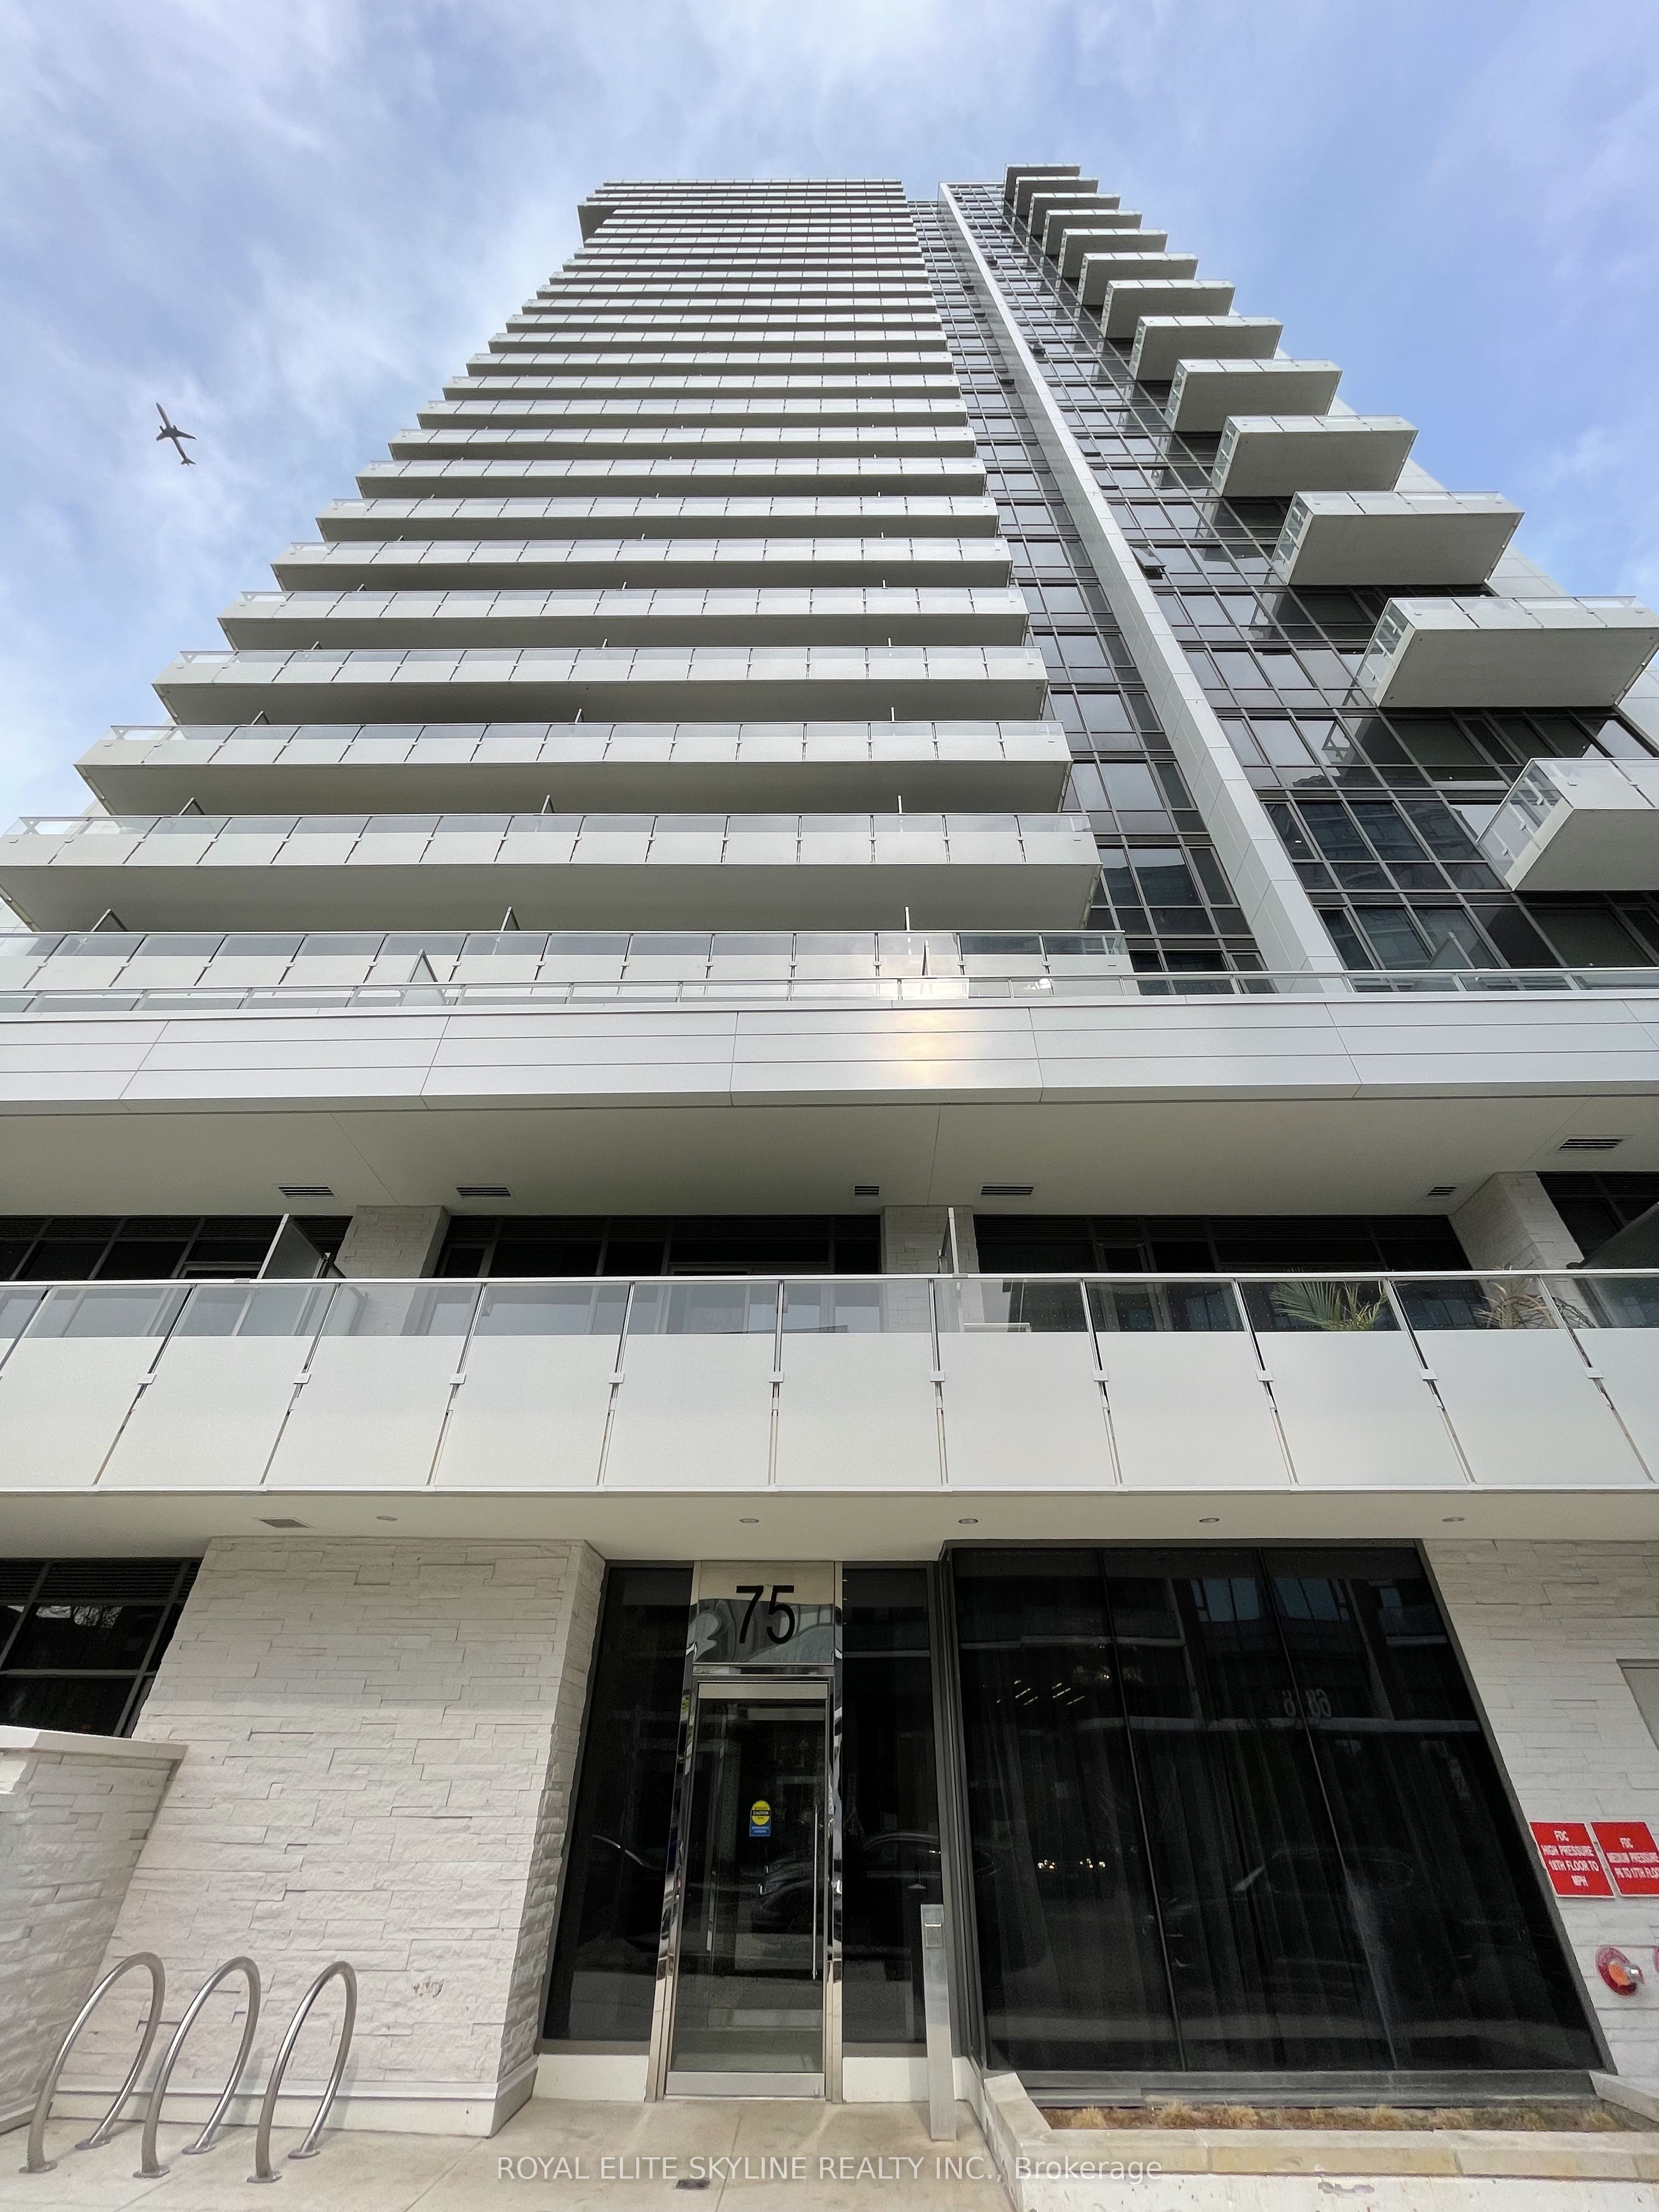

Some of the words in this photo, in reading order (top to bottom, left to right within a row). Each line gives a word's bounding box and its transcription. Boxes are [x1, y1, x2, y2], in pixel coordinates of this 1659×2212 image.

[736, 1584, 795, 1645] 75
[1554, 1830, 1569, 1842] FDC
[1619, 1837, 1634, 1849] FDC
[1541, 1844, 1559, 1856] HIGH
[1558, 1845, 1595, 1857] PRESSURE
[1628, 1852, 1659, 1864] PRESSURE
[1548, 1859, 1567, 1871] 18TH
[1565, 1860, 1590, 1872] FLOOR
[1587, 1860, 1599, 1872] TO
[1621, 1867, 1632, 1878] TO
